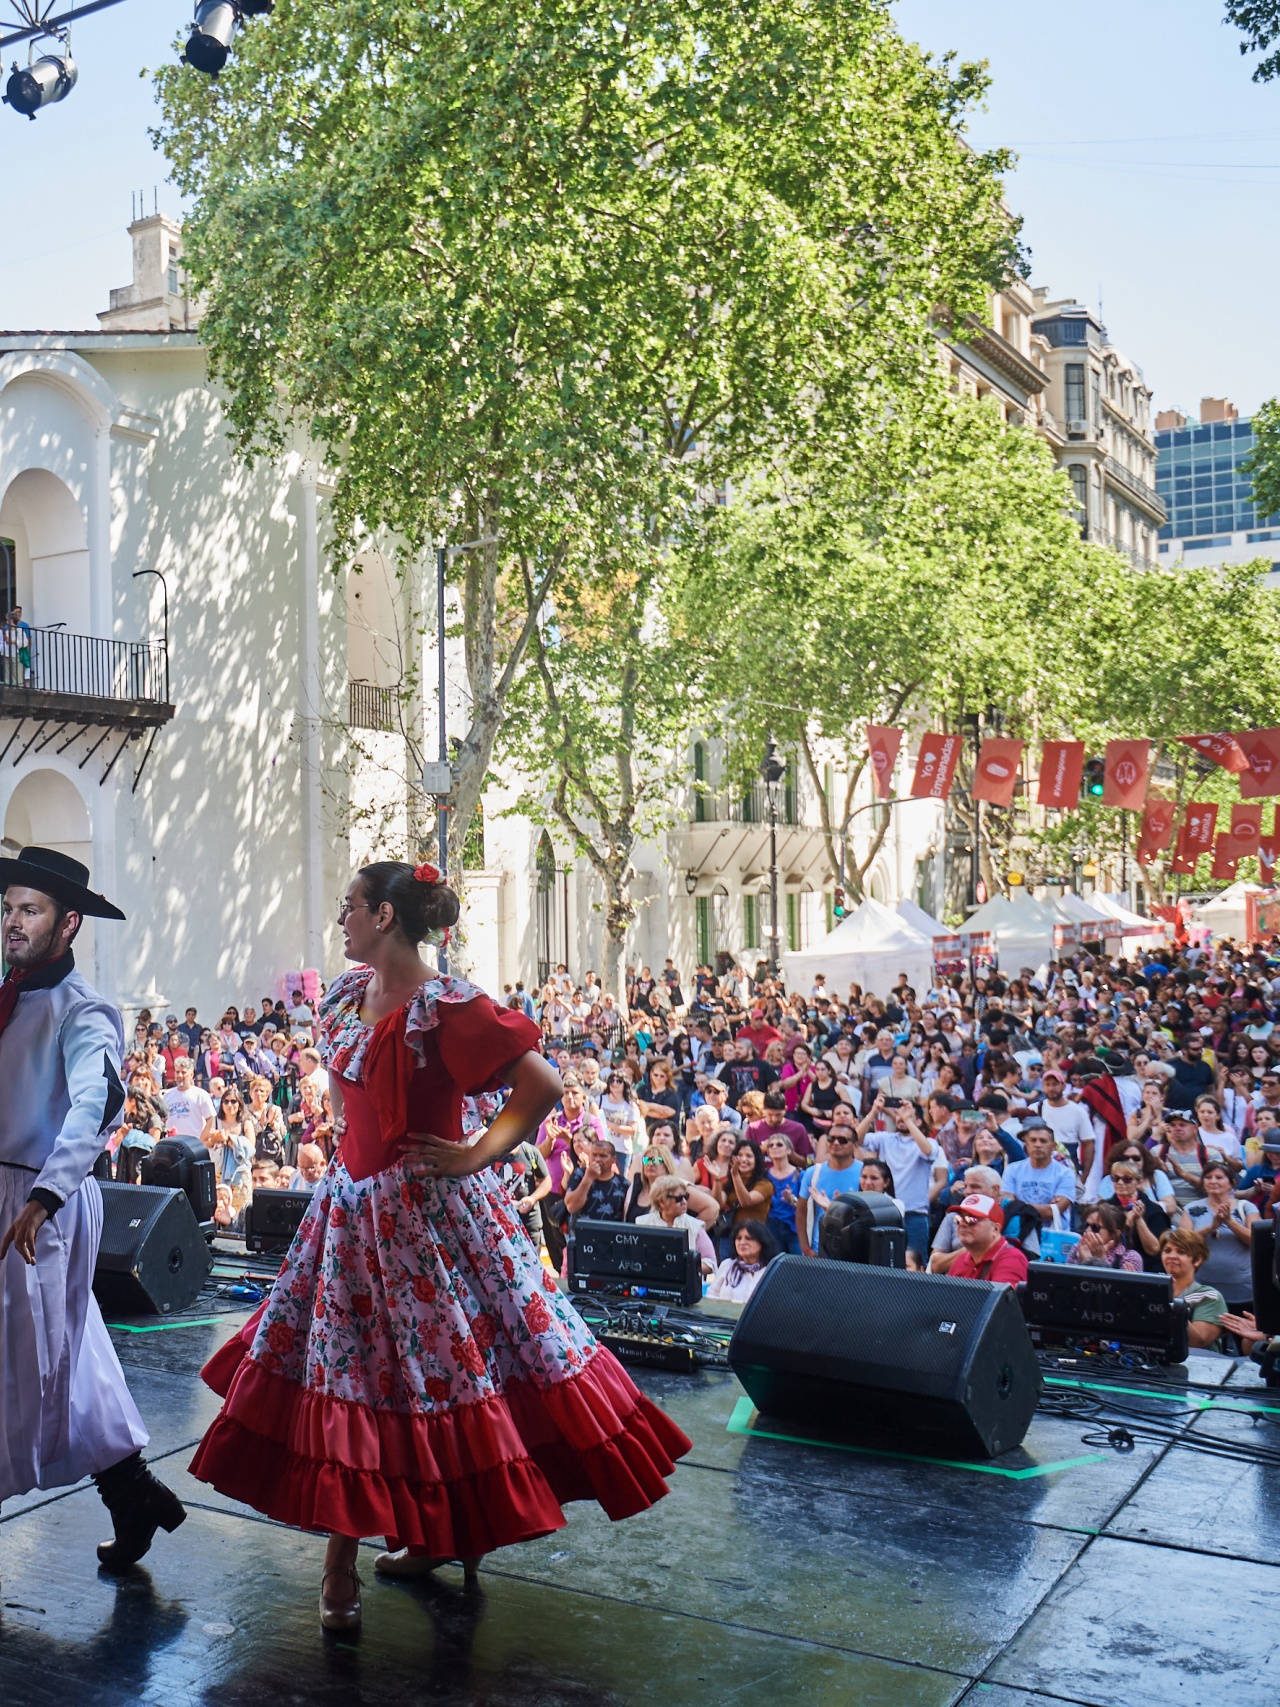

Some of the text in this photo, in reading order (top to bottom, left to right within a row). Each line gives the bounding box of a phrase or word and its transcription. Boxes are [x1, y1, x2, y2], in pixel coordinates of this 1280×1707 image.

[1212, 743, 1226, 756] Yo
[921, 765, 934, 778] Yo
[930, 737, 955, 797] Empanadas
[1189, 827, 1199, 838] Yo
[1199, 813, 1213, 843] Humita
[285, 1200, 306, 1209] CMY
[615, 1234, 639, 1245] CMY
[666, 1254, 677, 1262] 01
[618, 1260, 642, 1272] CMY
[1080, 1281, 1112, 1294] CMY
[1148, 1304, 1165, 1313] 06
[1081, 1310, 1114, 1323] CMY
